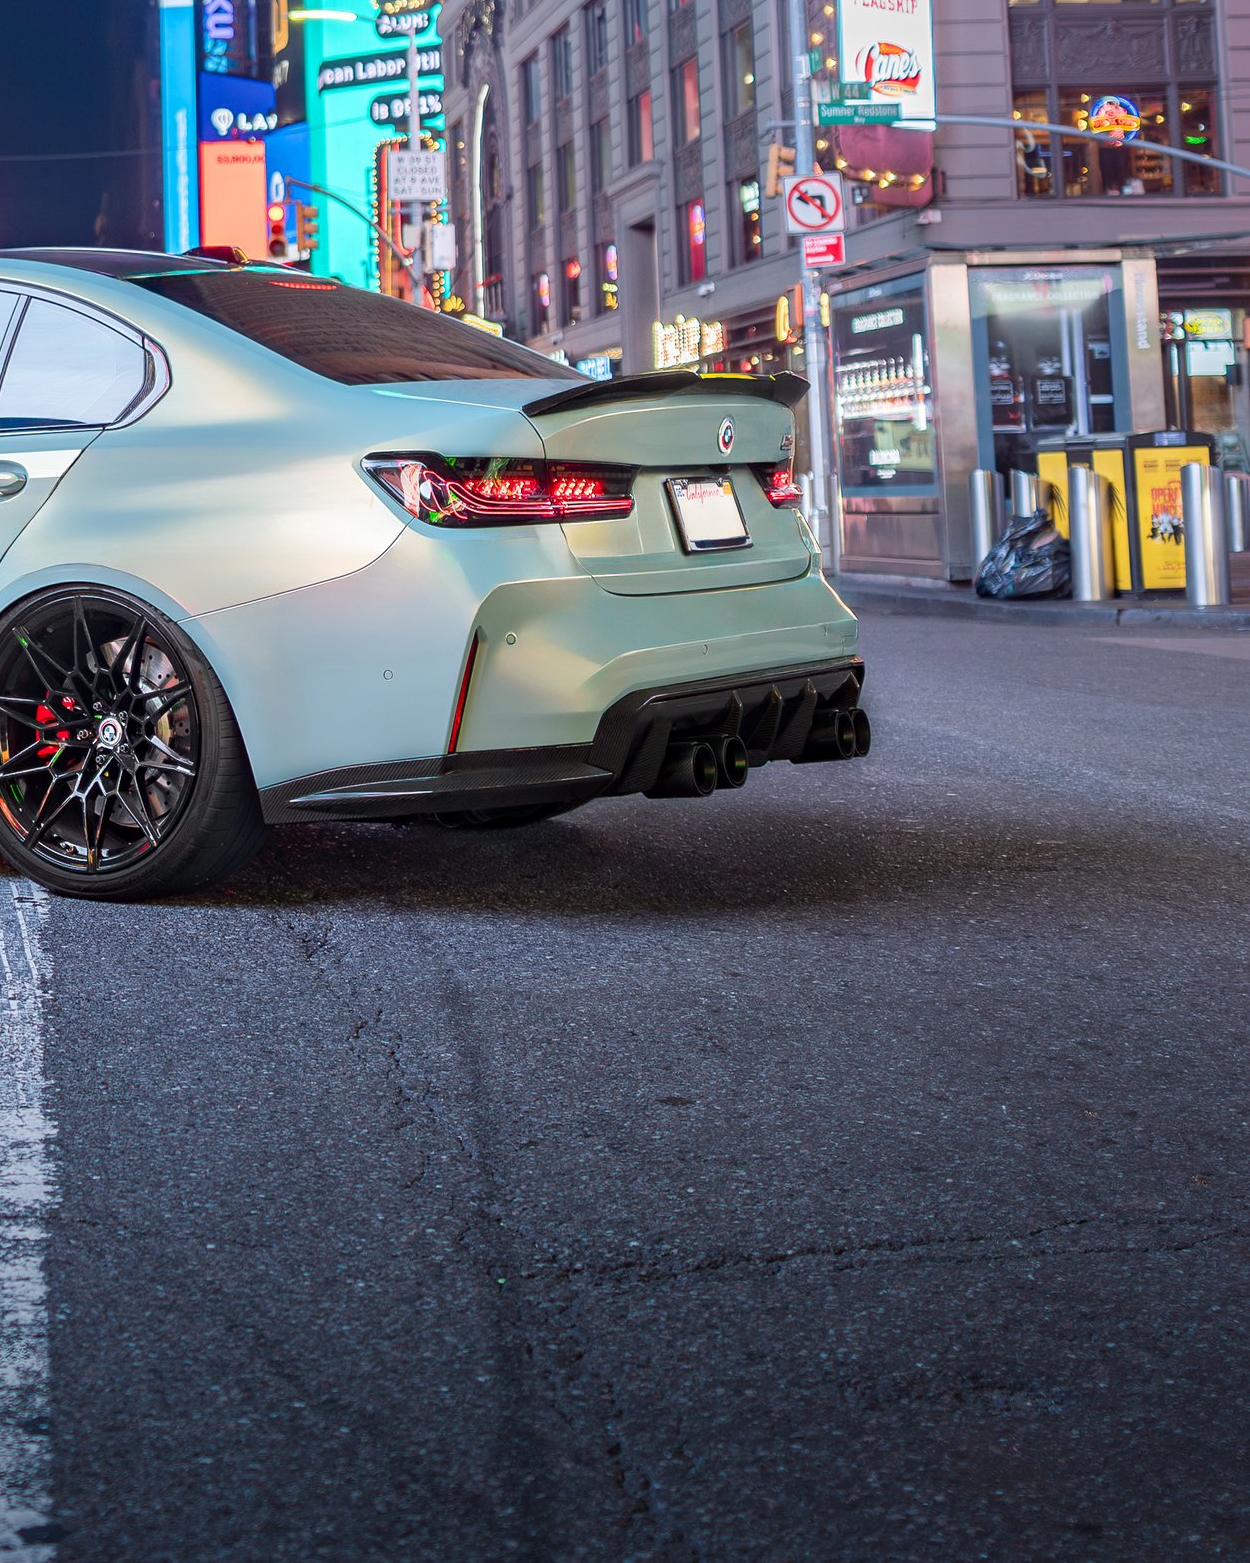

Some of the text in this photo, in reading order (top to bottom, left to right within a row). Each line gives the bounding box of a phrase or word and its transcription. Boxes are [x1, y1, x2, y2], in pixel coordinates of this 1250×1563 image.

[355, 57, 406, 80] Labor
[855, 43, 922, 85] Cane's
[844, 84, 860, 98] 44
[821, 105, 898, 117] Sumner Redstone
[397, 155, 406, 164] W
[397, 166, 438, 176] CLOSED
